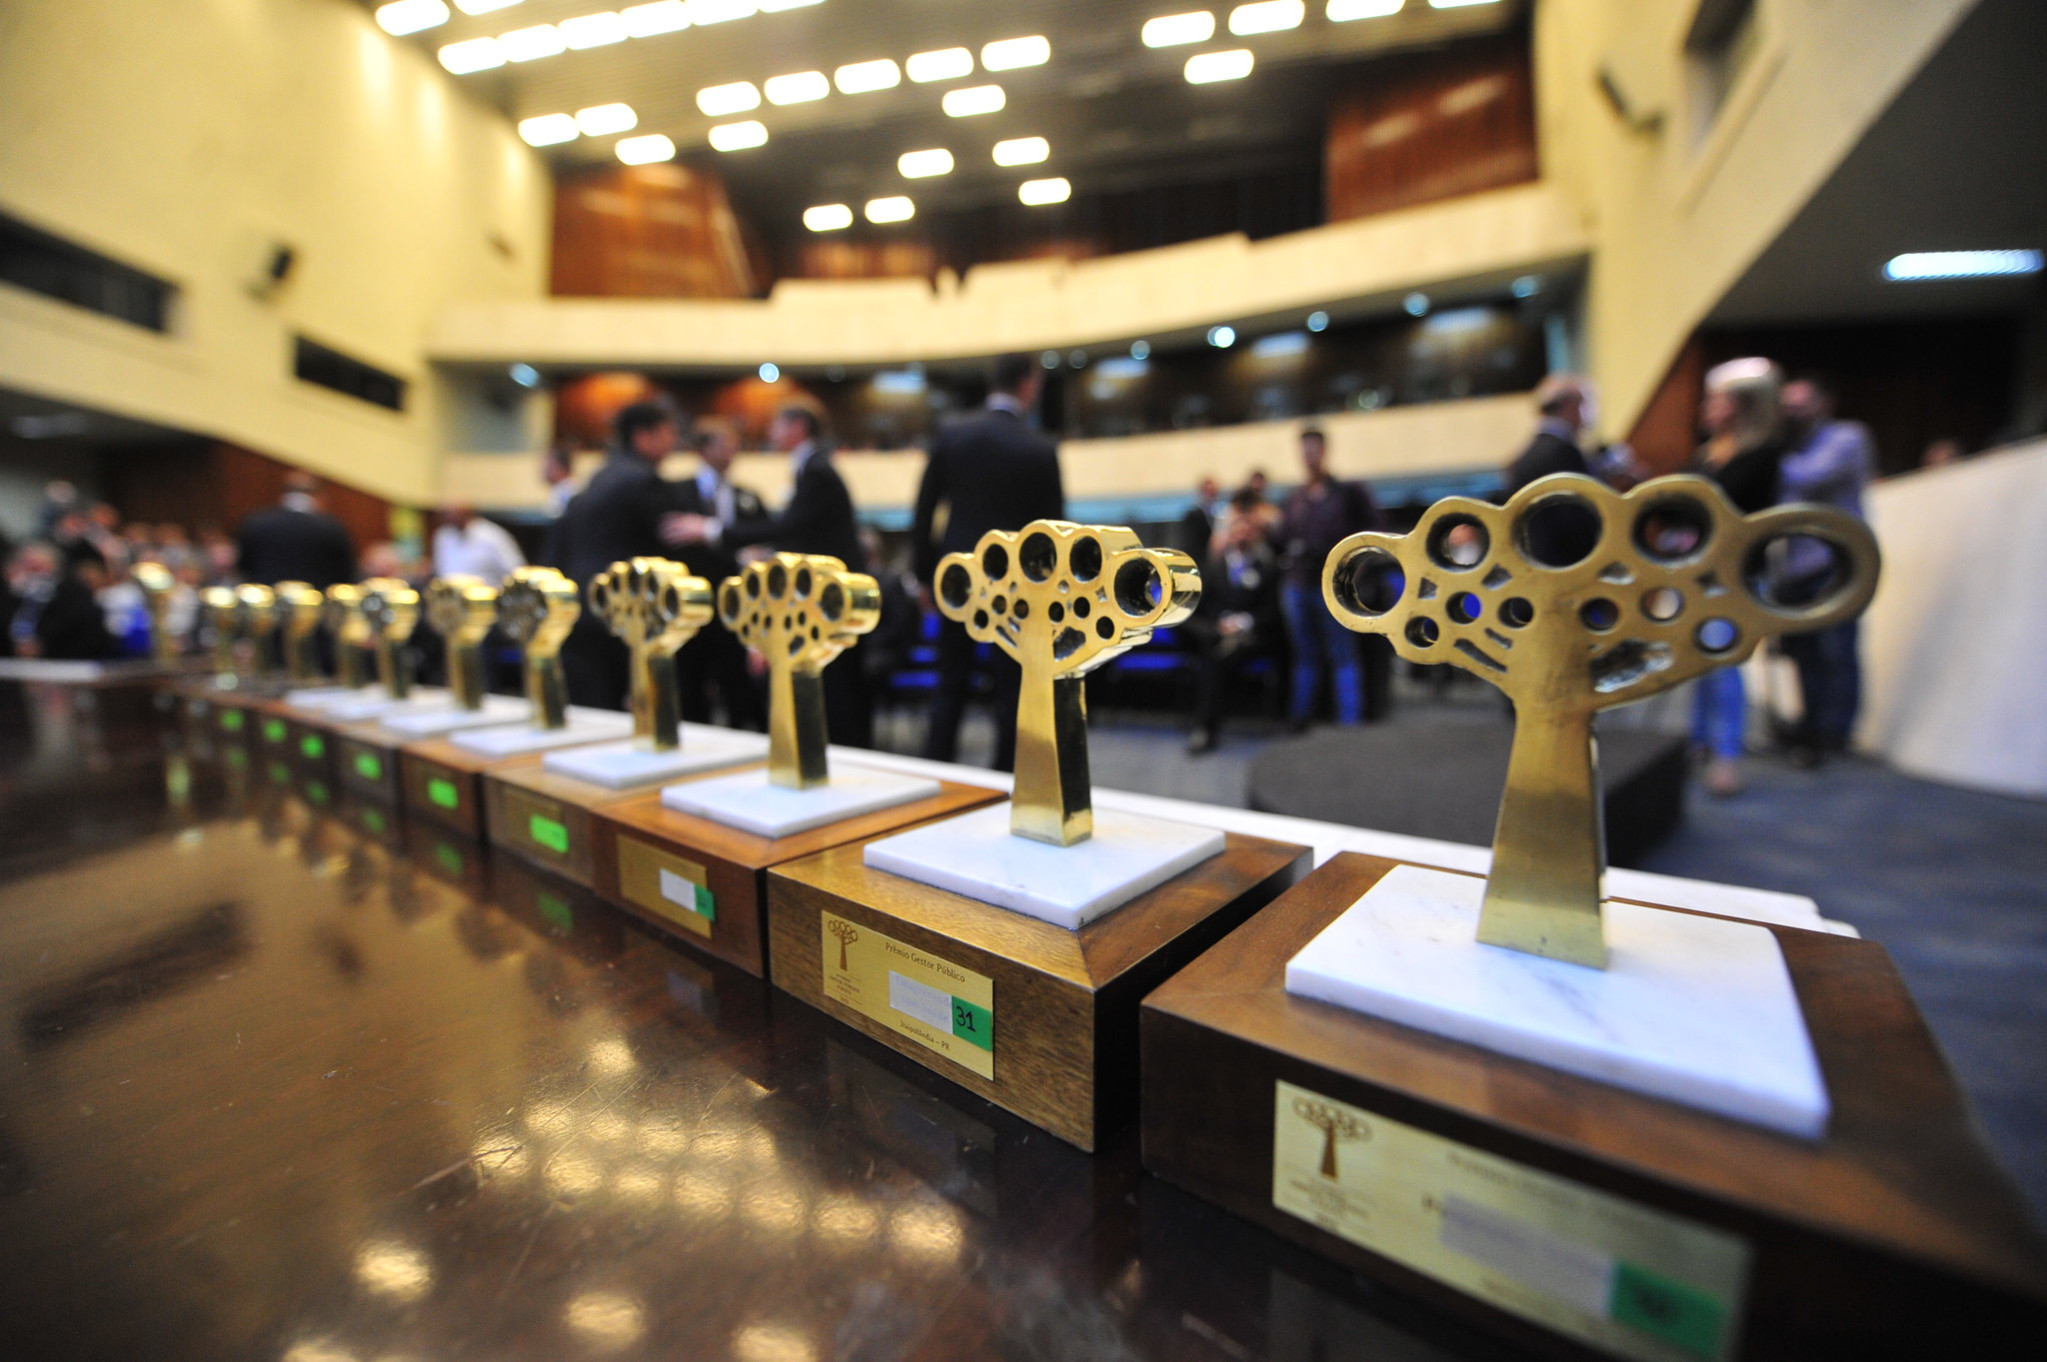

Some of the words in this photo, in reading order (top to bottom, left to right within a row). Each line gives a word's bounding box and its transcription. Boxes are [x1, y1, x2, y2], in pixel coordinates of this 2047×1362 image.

[885, 942, 910, 960] Prêmio
[911, 953, 935, 970] Gestor
[936, 963, 966, 982] Público
[955, 1005, 976, 1033] 31
